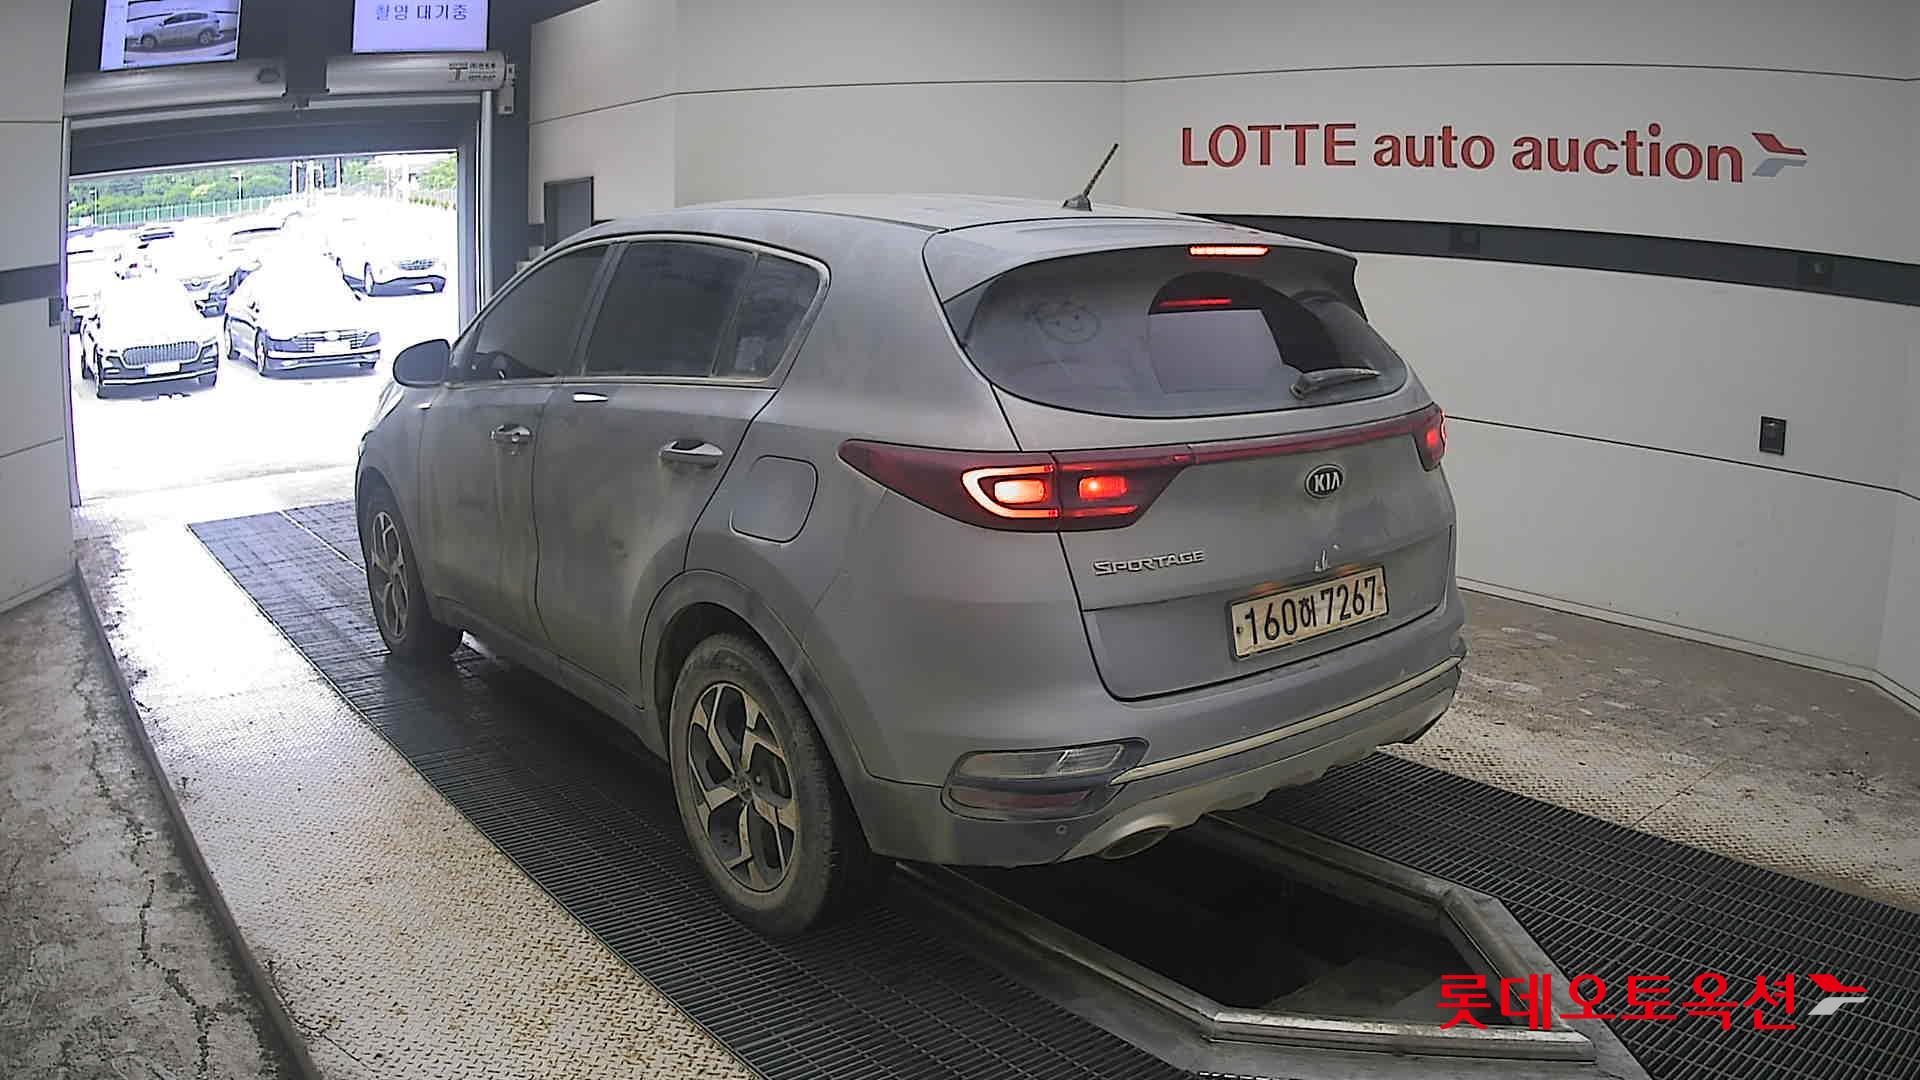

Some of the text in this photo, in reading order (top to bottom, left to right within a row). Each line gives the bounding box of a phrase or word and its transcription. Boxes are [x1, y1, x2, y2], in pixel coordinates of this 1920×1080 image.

[416, 4, 468, 20] 대기중
[1182, 123, 1744, 184] LOTTE auto auction
[1312, 471, 1343, 493] KIA
[1093, 550, 1205, 576] SPORTAGE
